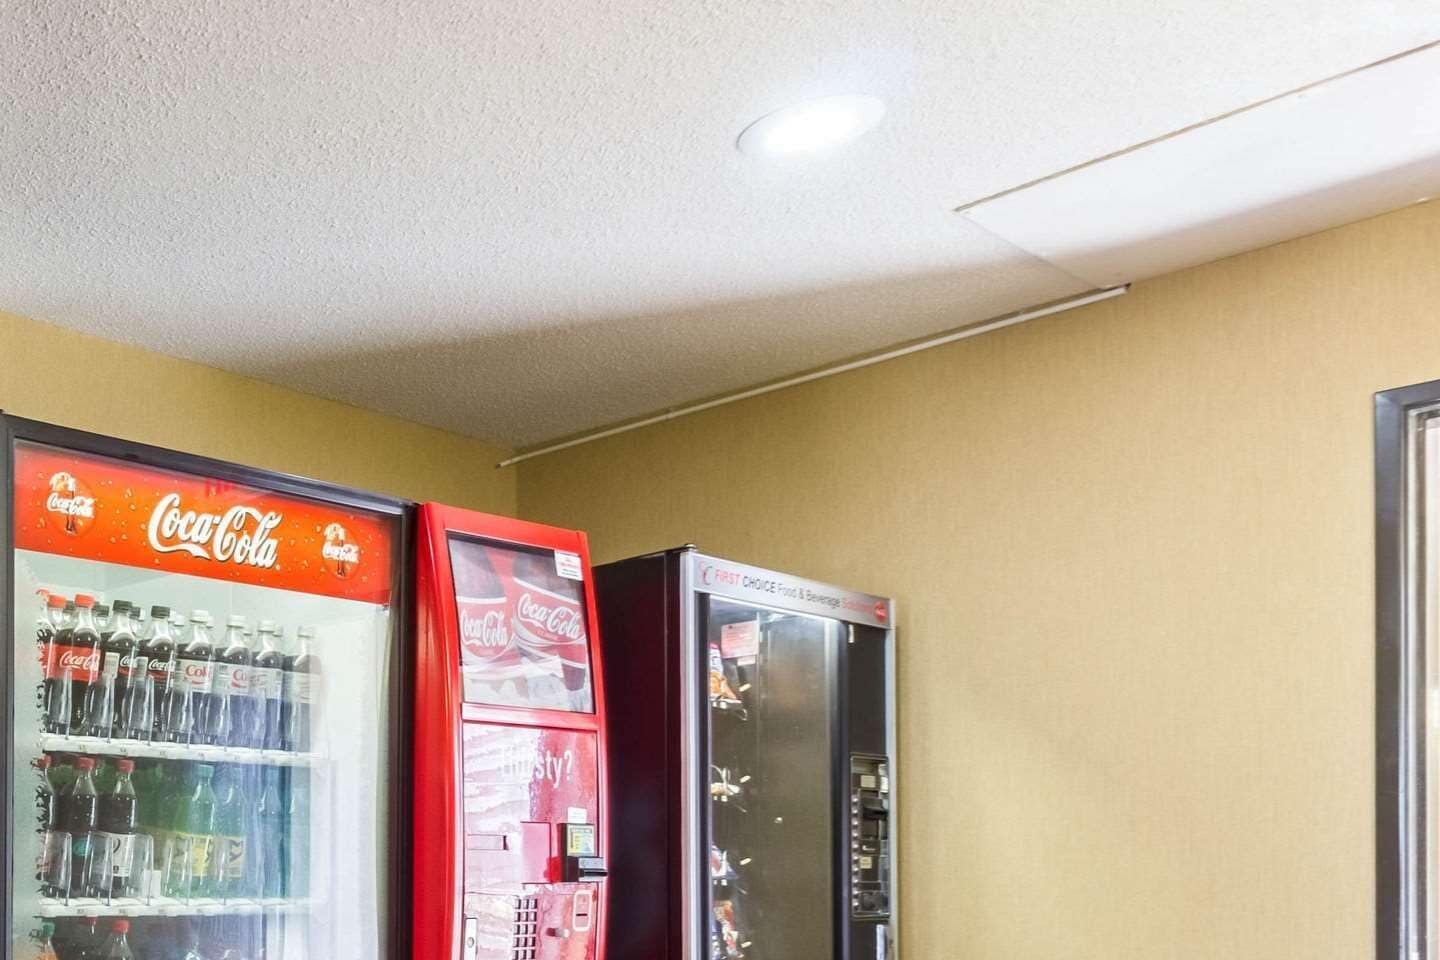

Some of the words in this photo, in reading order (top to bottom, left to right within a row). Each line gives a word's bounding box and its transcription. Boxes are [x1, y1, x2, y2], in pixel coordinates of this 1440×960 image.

[148, 493, 282, 568] Coca-Cola
[715, 569, 741, 586] FIRST
[742, 575, 776, 594] CHOICE
[461, 608, 508, 647] Coca-Cola
[518, 592, 582, 640] Coca-Cola
